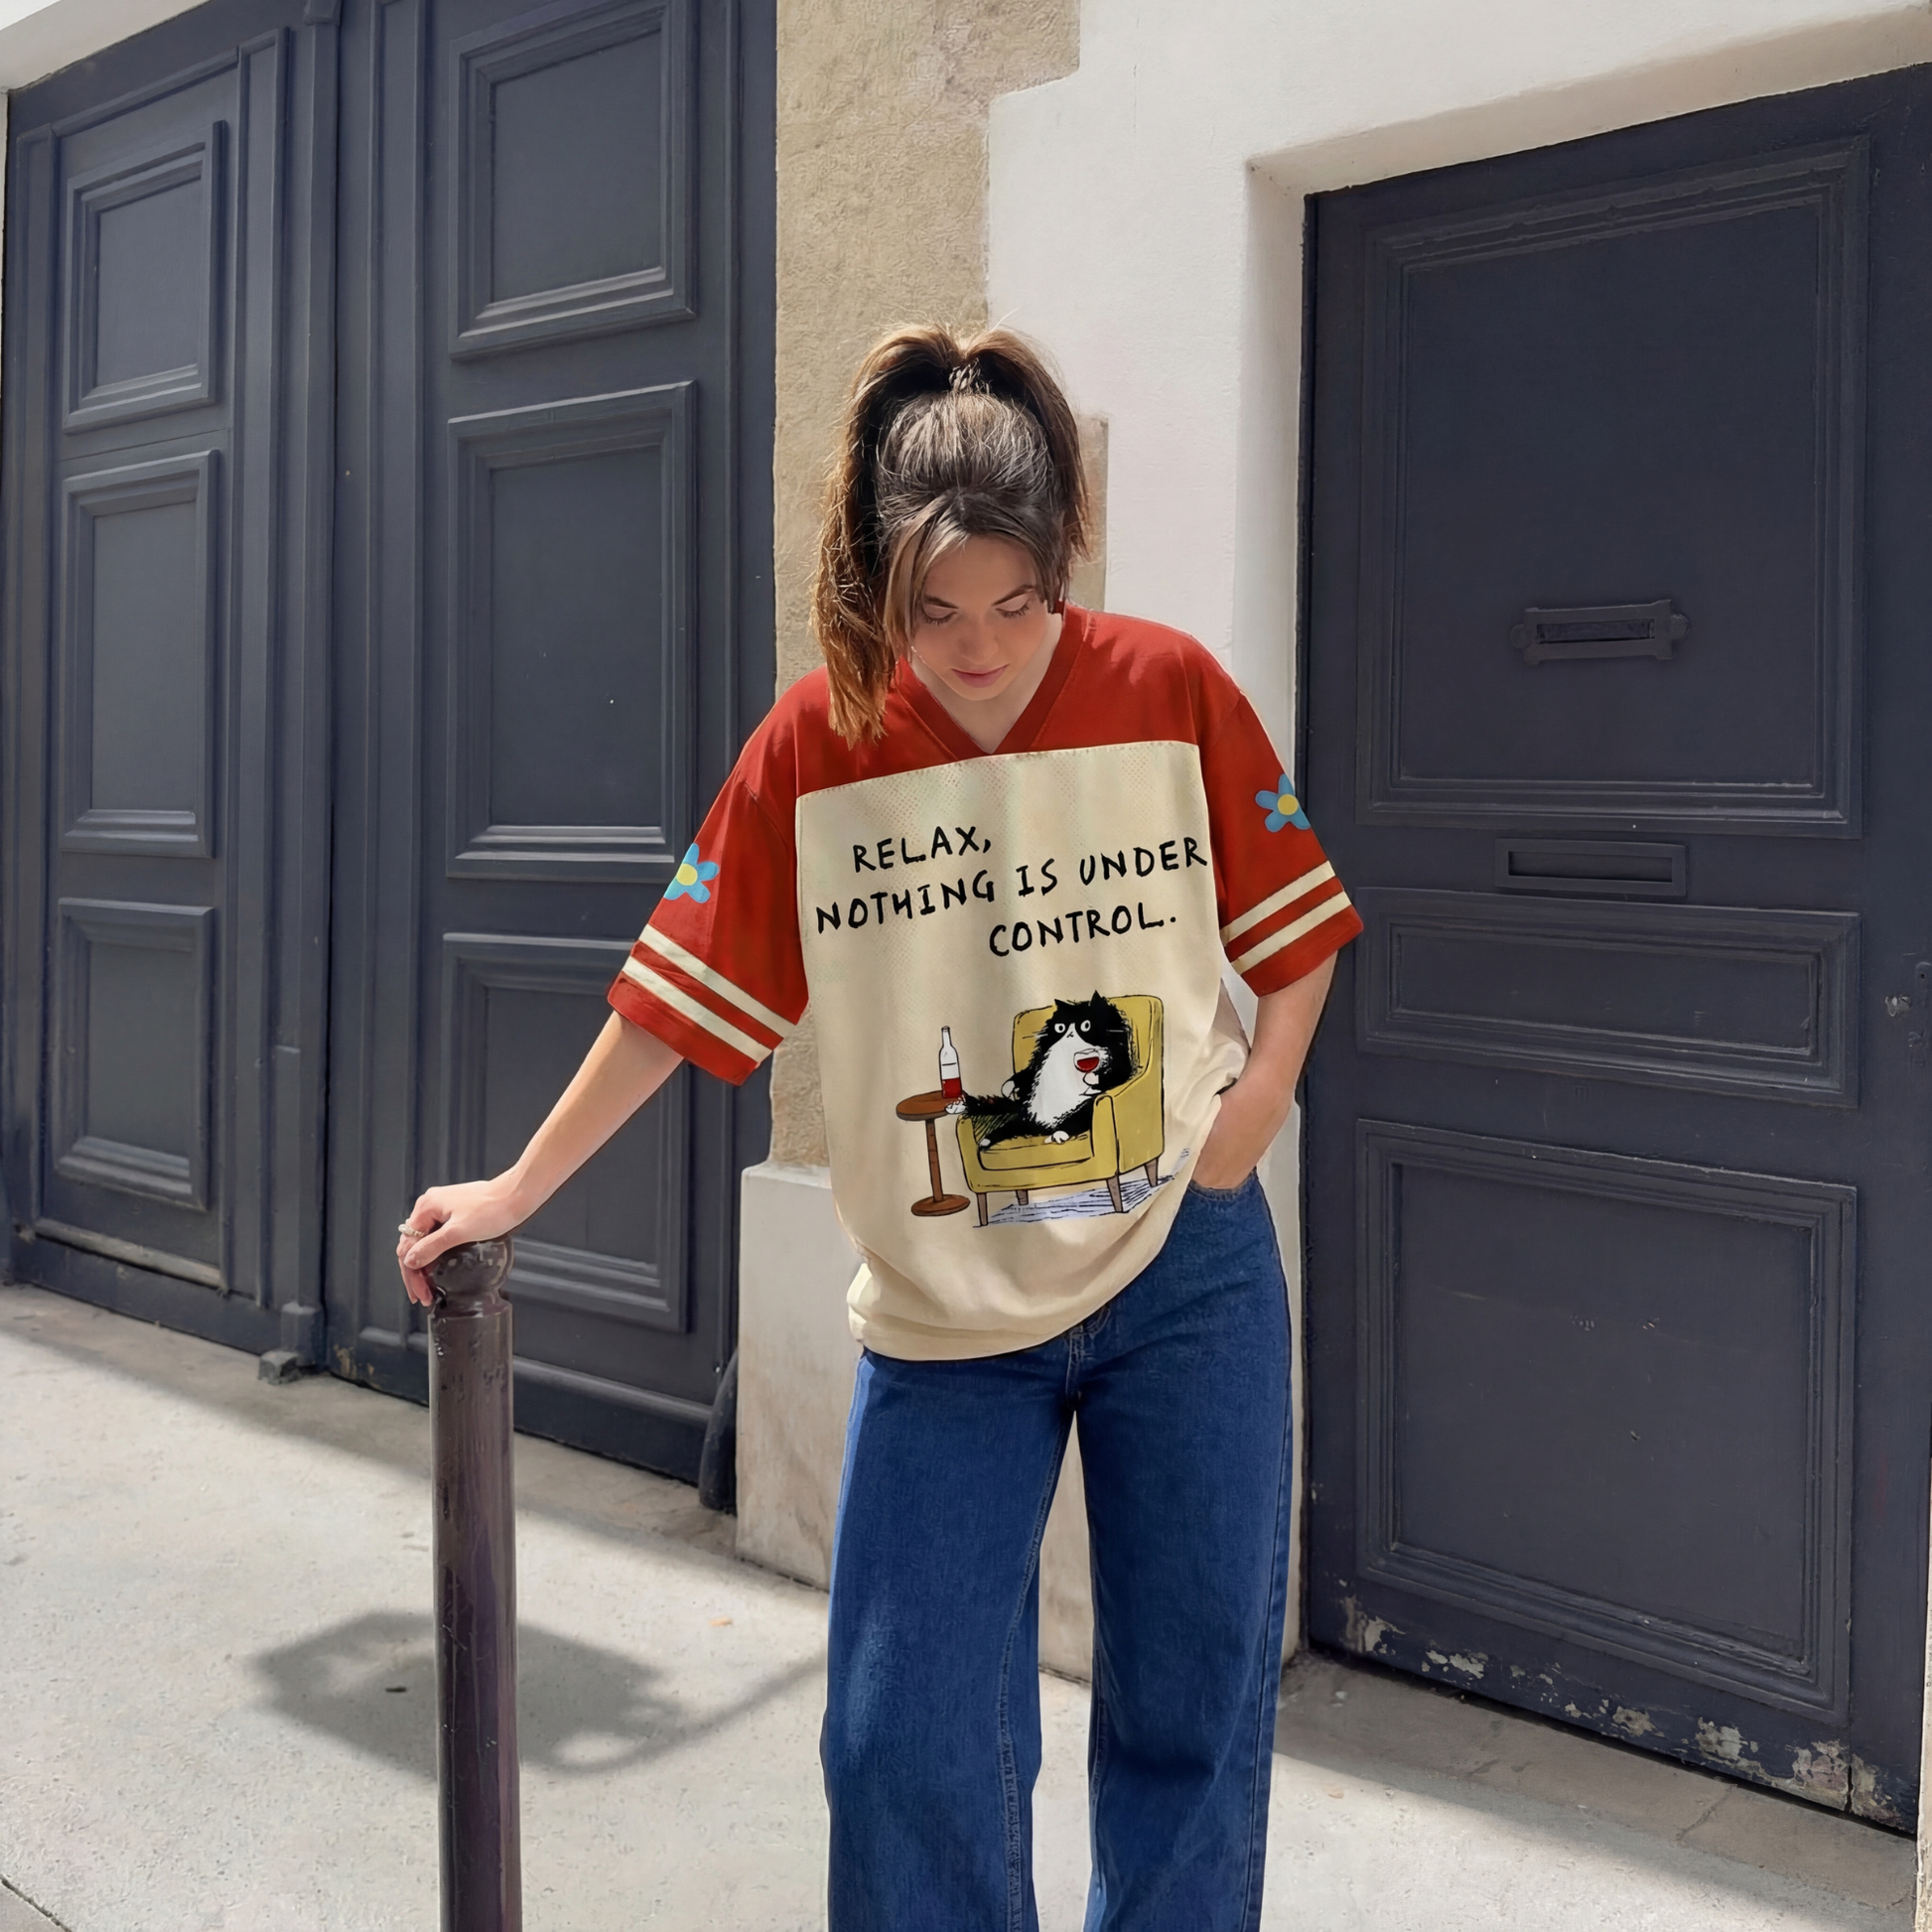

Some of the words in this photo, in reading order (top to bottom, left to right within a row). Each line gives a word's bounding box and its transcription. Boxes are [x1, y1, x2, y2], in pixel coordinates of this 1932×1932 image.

[853, 826, 992, 874] RELAX,
[816, 870, 995, 934] NOTHING
[1016, 859, 1058, 897] IS
[1079, 837, 1208, 887] UNDER
[989, 901, 1176, 957] CONTROL.
